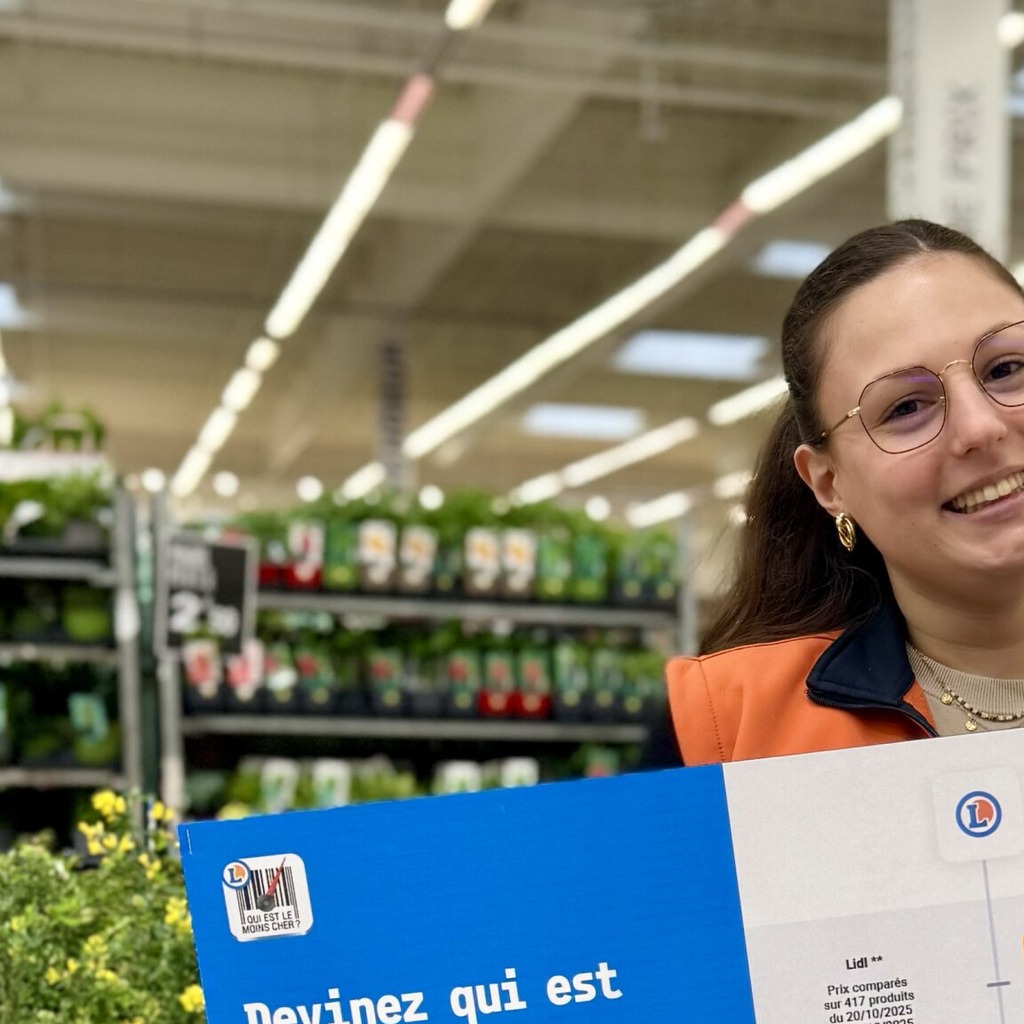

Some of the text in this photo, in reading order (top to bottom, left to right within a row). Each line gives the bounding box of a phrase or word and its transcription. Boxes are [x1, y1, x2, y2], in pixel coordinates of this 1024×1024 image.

[247, 910, 292, 924] QUI EST LE
[242, 920, 294, 934] MOINS CHER
[845, 957, 868, 970] Lidl
[546, 962, 623, 1005] est
[827, 977, 908, 996] Prix comparés
[824, 991, 915, 1010] sur 417 produits
[829, 1004, 913, 1024] du 20/10/2025
